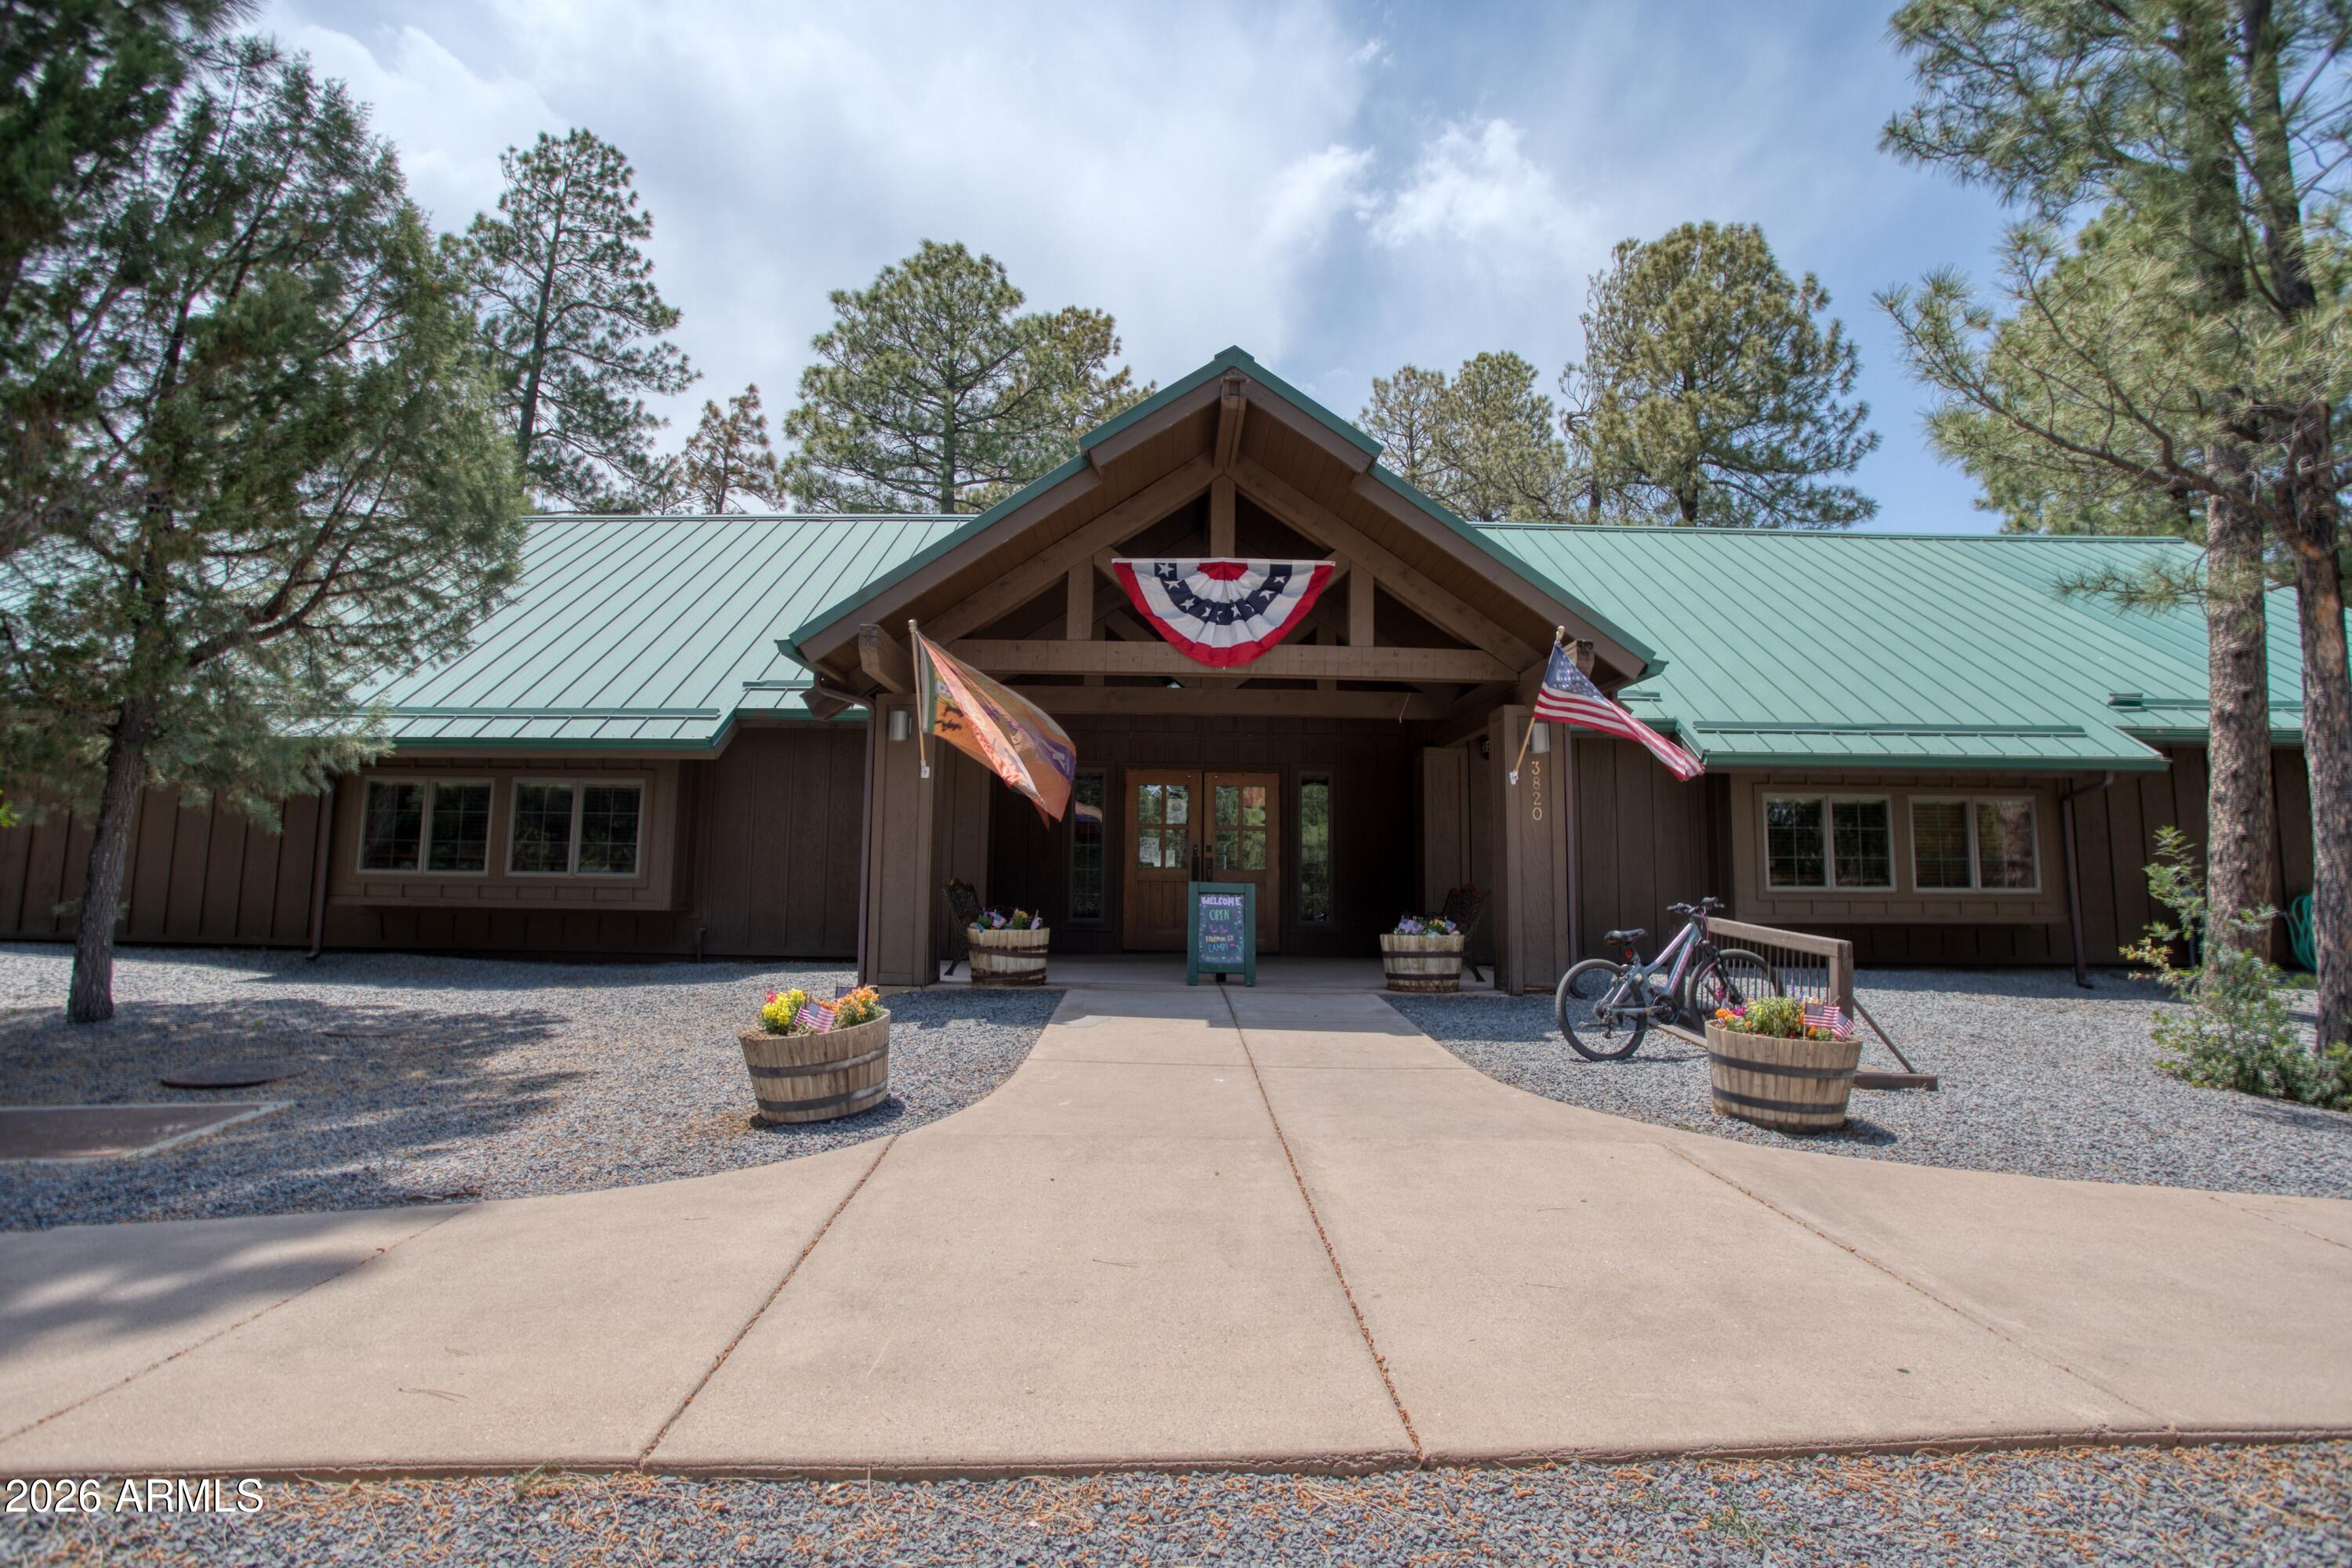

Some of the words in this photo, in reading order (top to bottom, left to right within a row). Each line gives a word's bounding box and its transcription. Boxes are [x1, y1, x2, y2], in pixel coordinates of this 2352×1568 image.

[1531, 760, 1542, 821] 3820
[1201, 896, 1241, 906] WELCOME
[1209, 909, 1229, 921] OPEN
